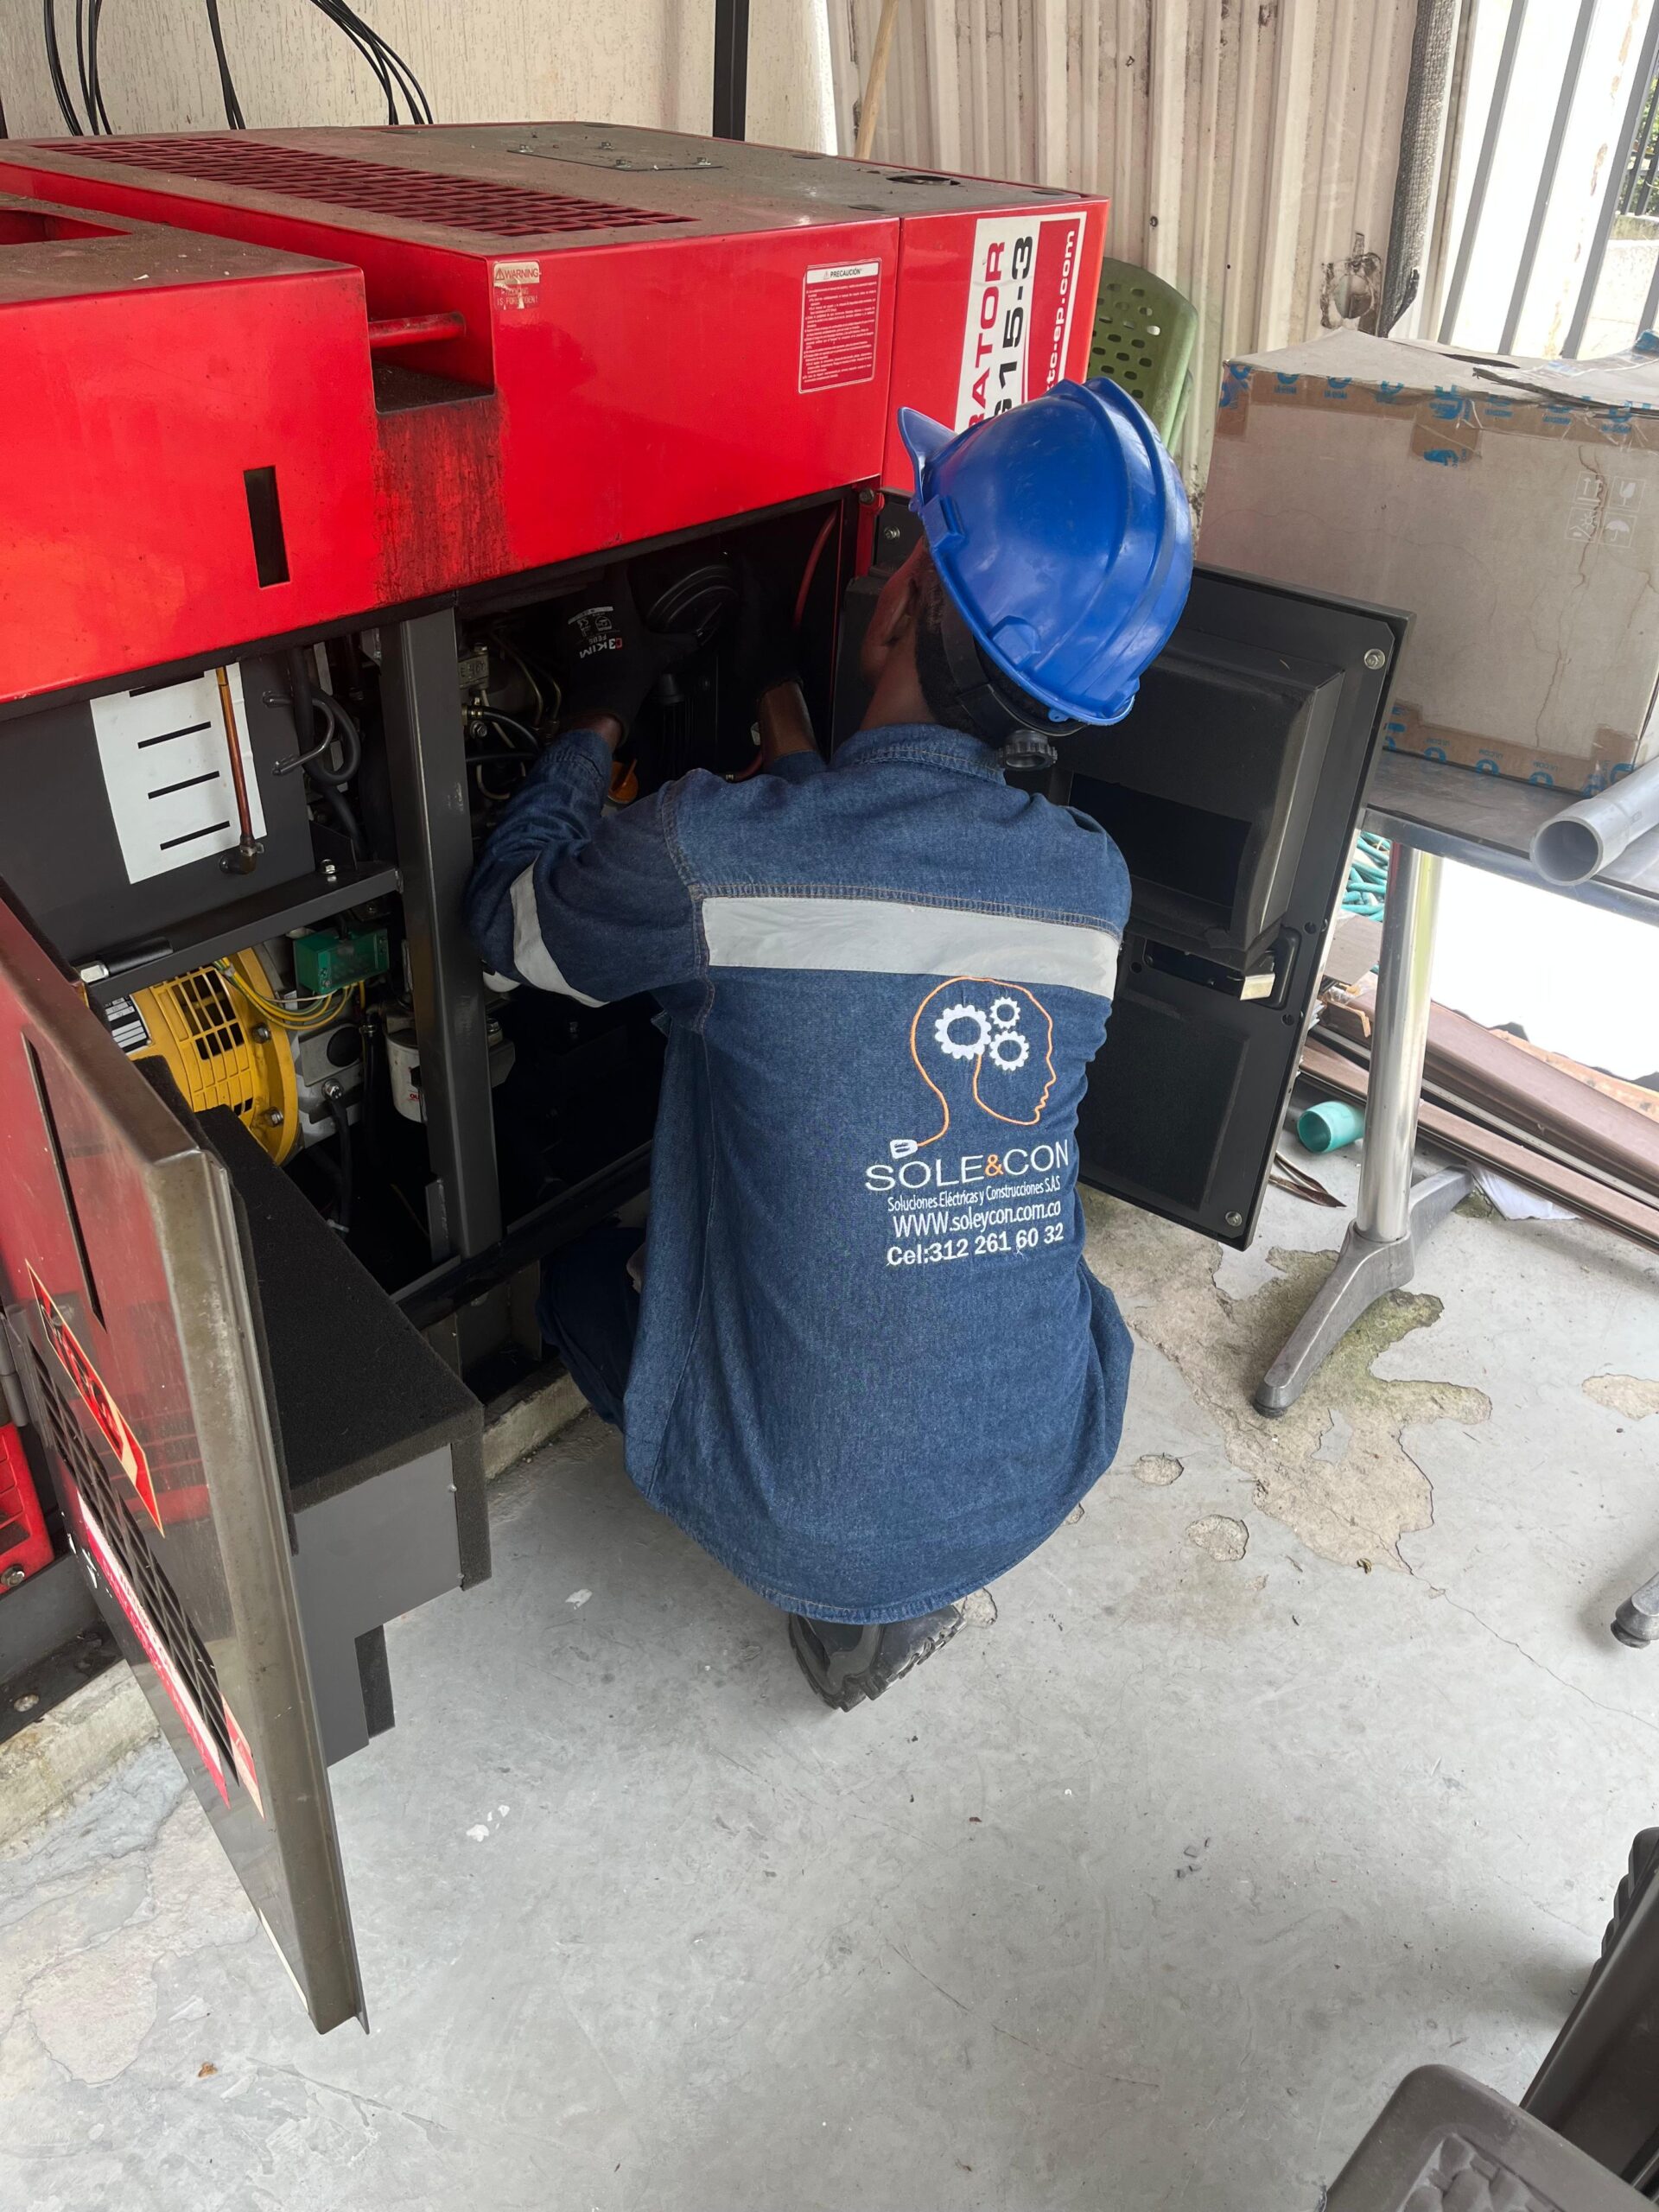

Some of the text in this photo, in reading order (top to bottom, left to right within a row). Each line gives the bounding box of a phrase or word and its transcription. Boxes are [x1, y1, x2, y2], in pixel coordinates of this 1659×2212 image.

[505, 269, 538, 279] WARNING
[830, 268, 861, 278] PRECAUCIÓN
[866, 1139, 1069, 1192] SOLE&CON
[887, 1194, 938, 1211] Soluciones
[939, 1190, 978, 1207] Eléctricas
[978, 1191, 985, 1205] y
[986, 1181, 1044, 1201] Construcciones
[893, 1200, 1061, 1238] WWW.soleycon.com.co
[975, 1231, 1011, 1255] 261
[1016, 1228, 1039, 1249] 60
[1045, 1224, 1065, 1244] 32
